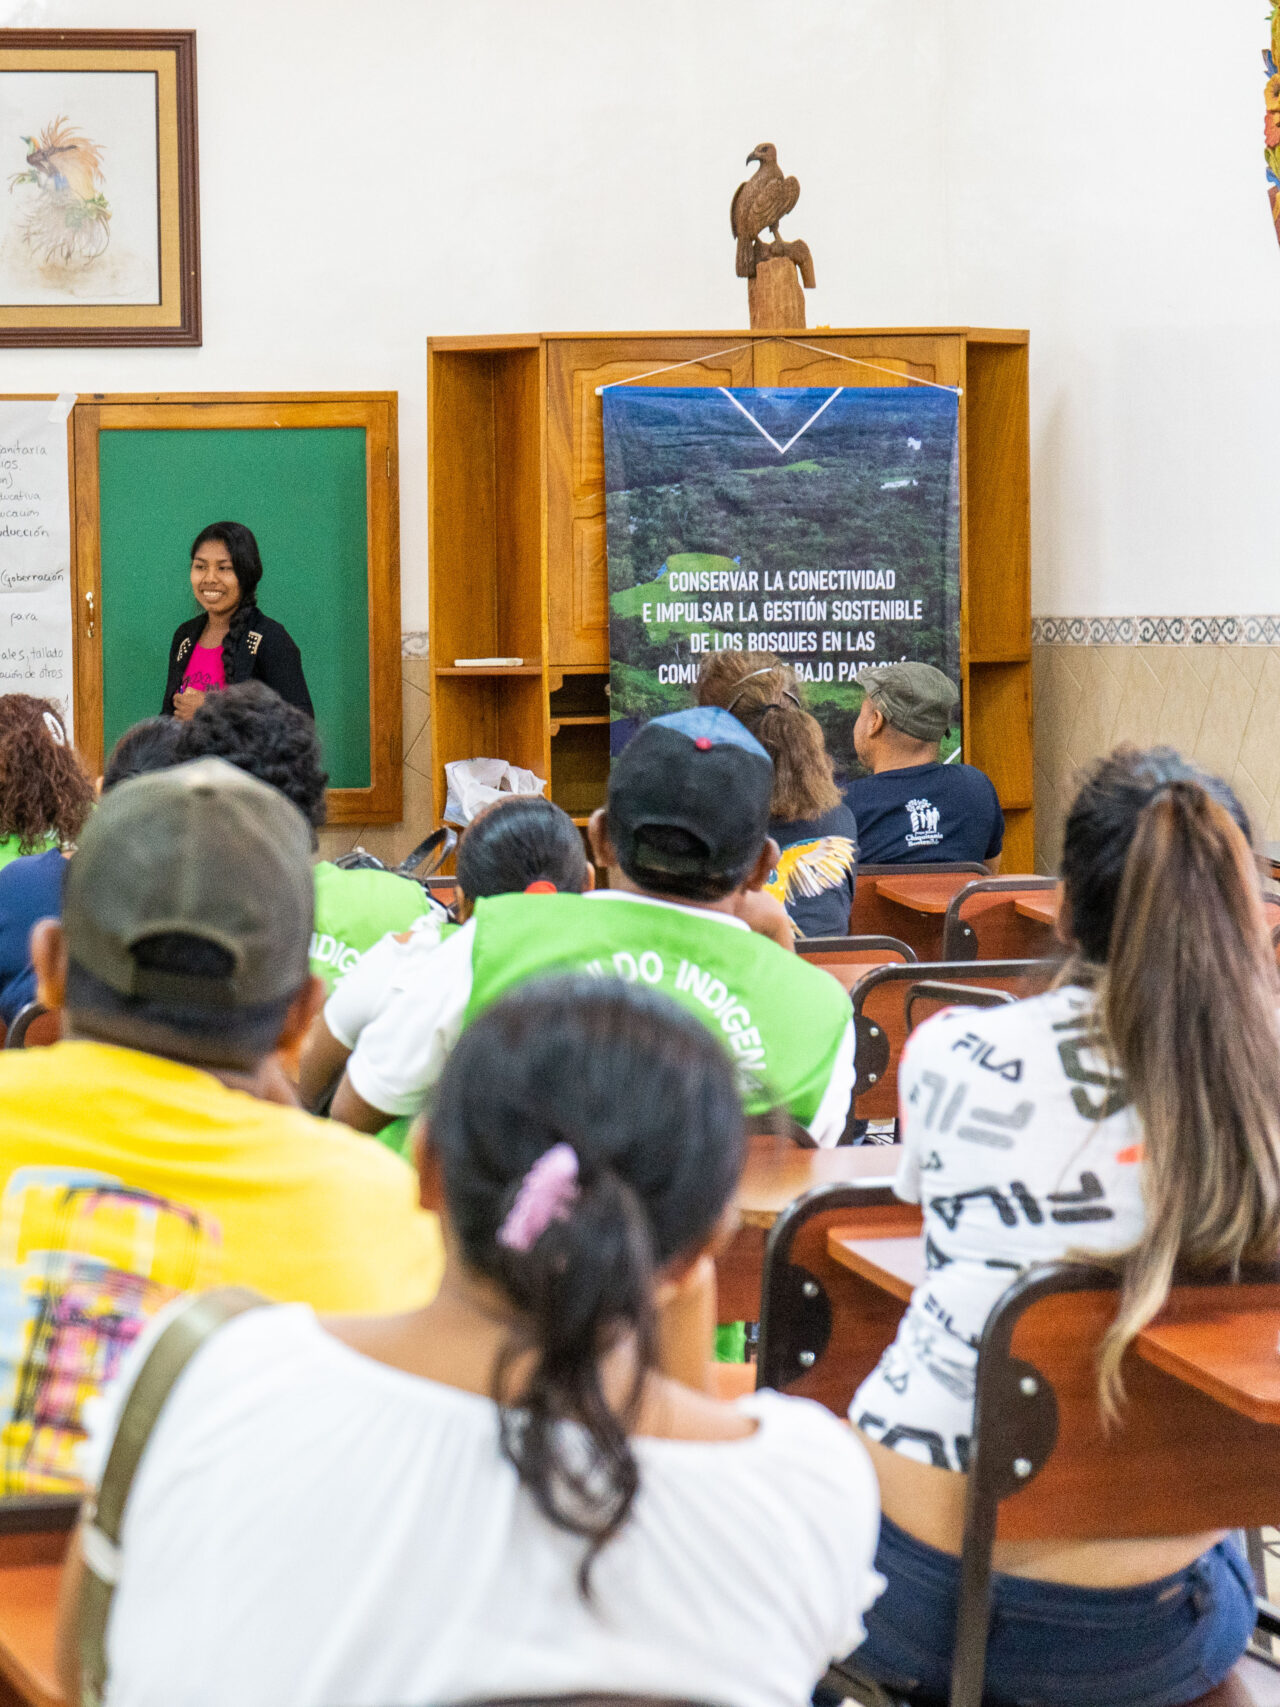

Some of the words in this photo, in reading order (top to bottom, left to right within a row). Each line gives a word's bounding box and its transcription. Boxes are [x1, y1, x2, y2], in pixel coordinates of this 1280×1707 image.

[669, 571, 759, 592] CONSERVAR
[764, 570, 784, 591] LA
[788, 569, 896, 591] CONECTIVIDAD
[10, 612, 39, 627] para
[642, 602, 652, 623] E
[656, 602, 734, 623] IMPULSAR
[739, 601, 759, 622] LA
[763, 595, 827, 622] GESTIÓN
[832, 600, 923, 621] SOSTENIBLE
[690, 633, 710, 654] DE
[714, 632, 743, 652] LOS
[747, 632, 818, 652] BOSQUES
[822, 632, 841, 651] EN
[846, 631, 876, 651] LAS
[39, 663, 64, 680] otros
[794, 662, 834, 683] BAJO
[675, 959, 766, 1075] INDIGEN
[952, 1031, 1024, 1083] FILA
